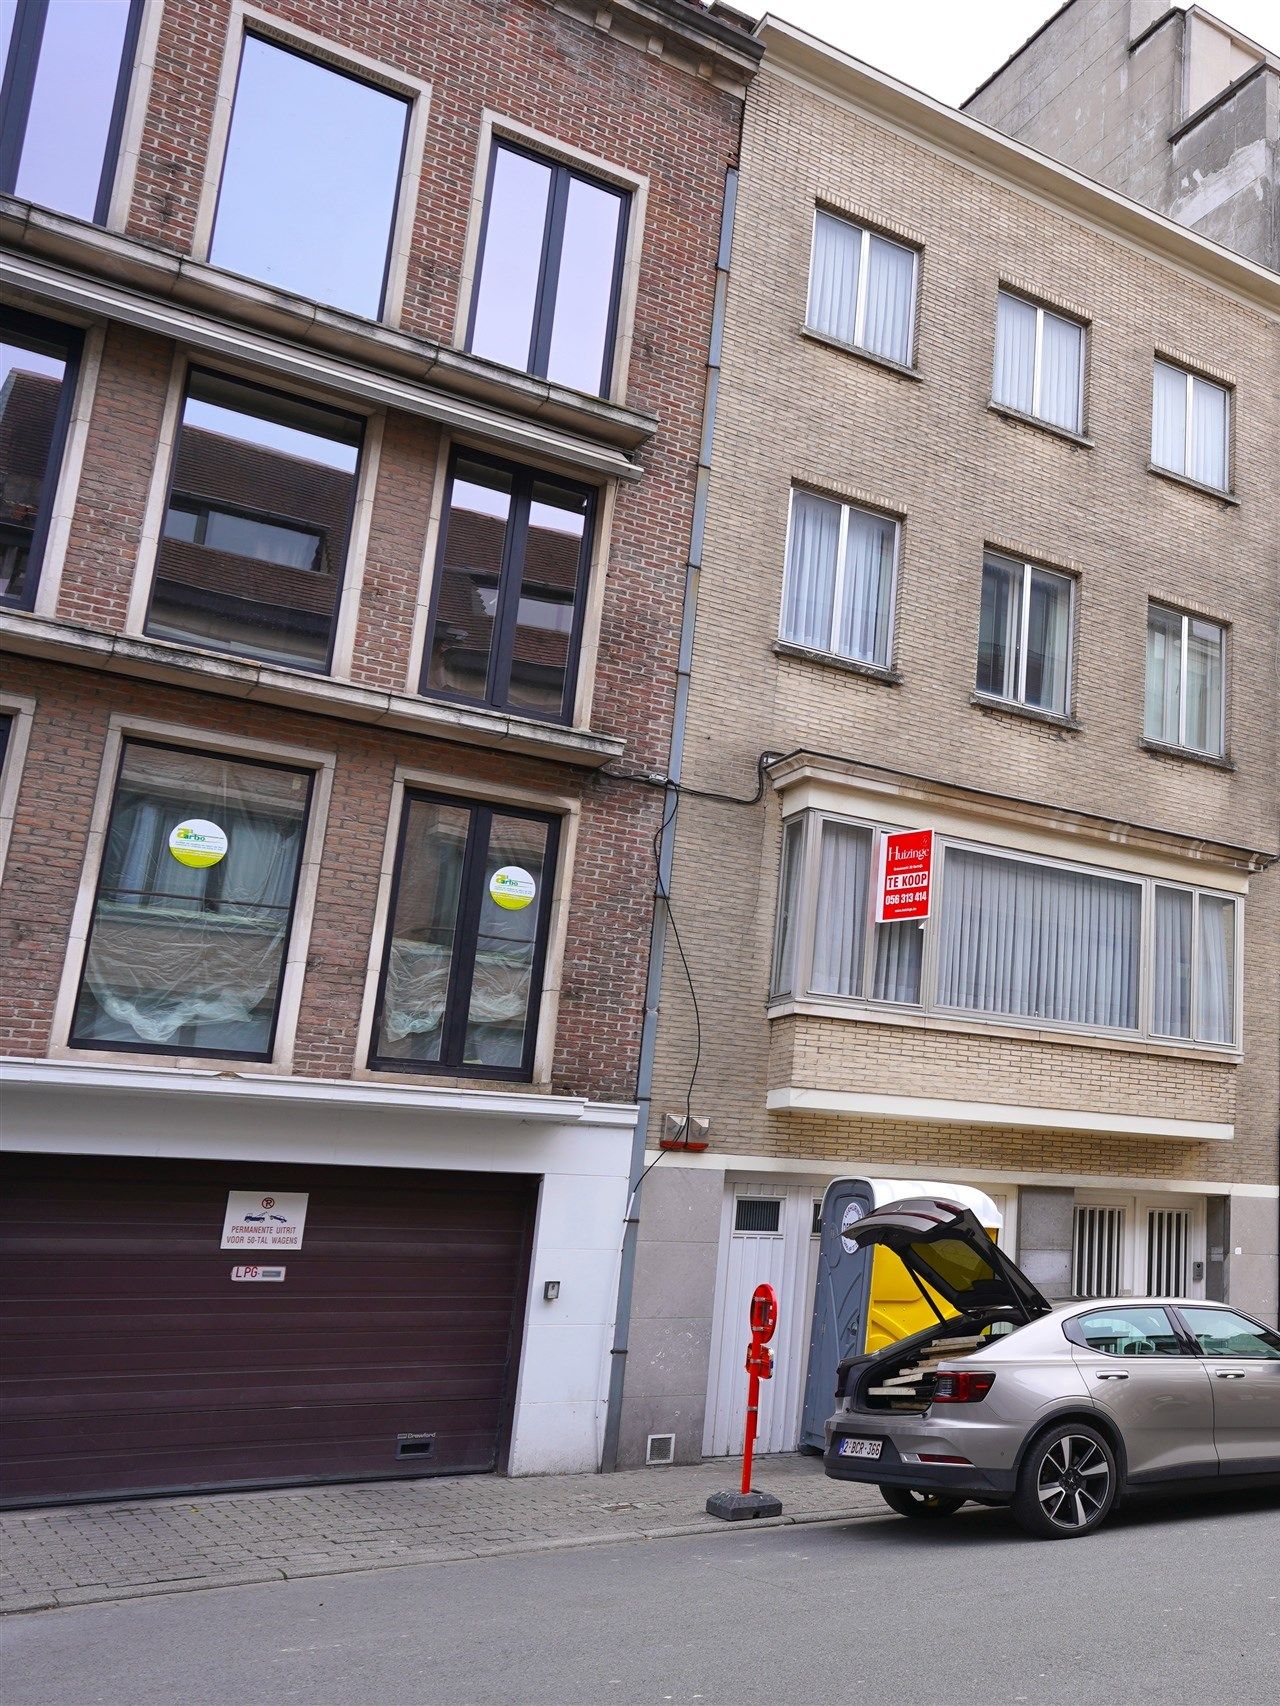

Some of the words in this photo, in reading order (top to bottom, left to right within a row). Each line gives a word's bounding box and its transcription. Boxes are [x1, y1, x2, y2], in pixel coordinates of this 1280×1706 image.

[888, 876, 899, 888] TE
[901, 873, 927, 887] KOOP
[885, 894, 900, 905] 056
[901, 892, 914, 903] 313
[914, 890, 927, 902] 414
[231, 1226, 273, 1234] PERMANENTE
[275, 1226, 296, 1235] UITRIT
[226, 1235, 244, 1244] VOOR
[271, 1236, 298, 1245] WAGENS
